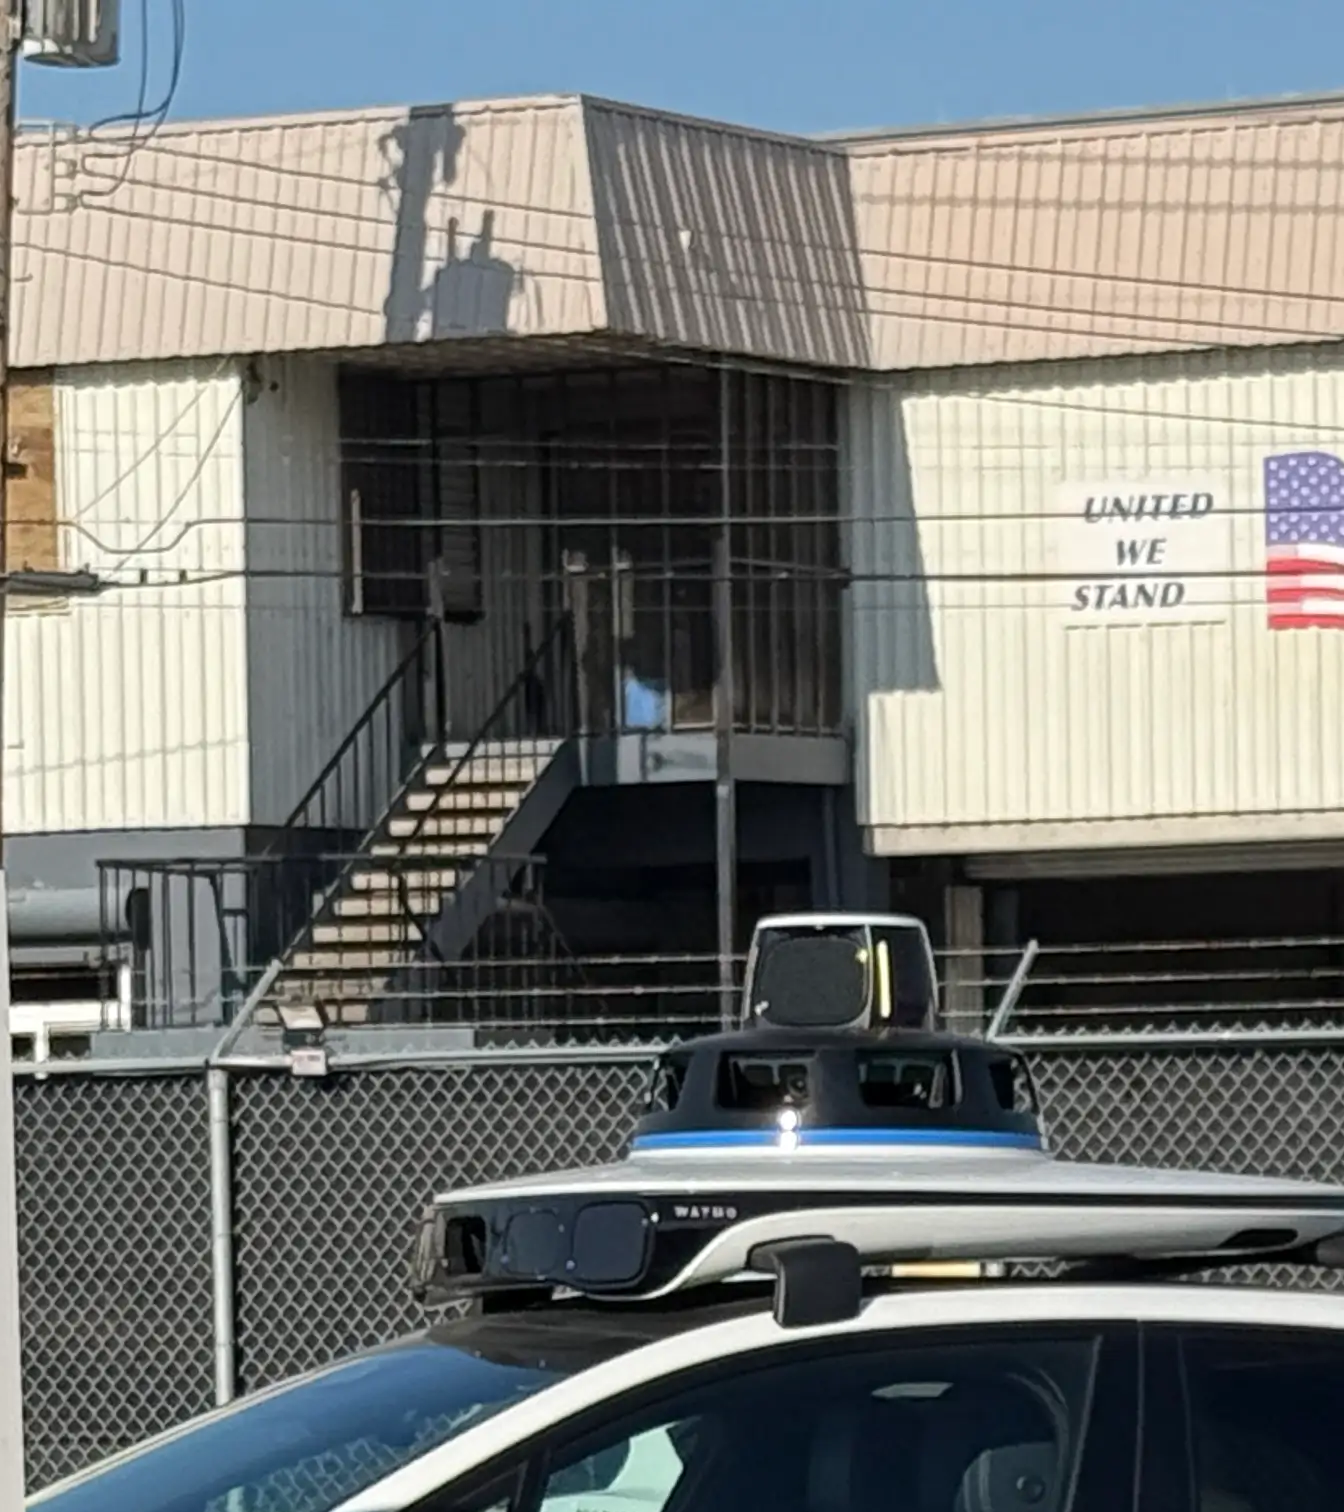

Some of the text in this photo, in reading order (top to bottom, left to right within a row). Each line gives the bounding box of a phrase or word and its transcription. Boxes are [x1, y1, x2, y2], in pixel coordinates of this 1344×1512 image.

[1084, 492, 1214, 523] UNITED
[1116, 537, 1167, 566] WE
[1071, 582, 1185, 611] STAND
[674, 1205, 737, 1220] WAYMO
